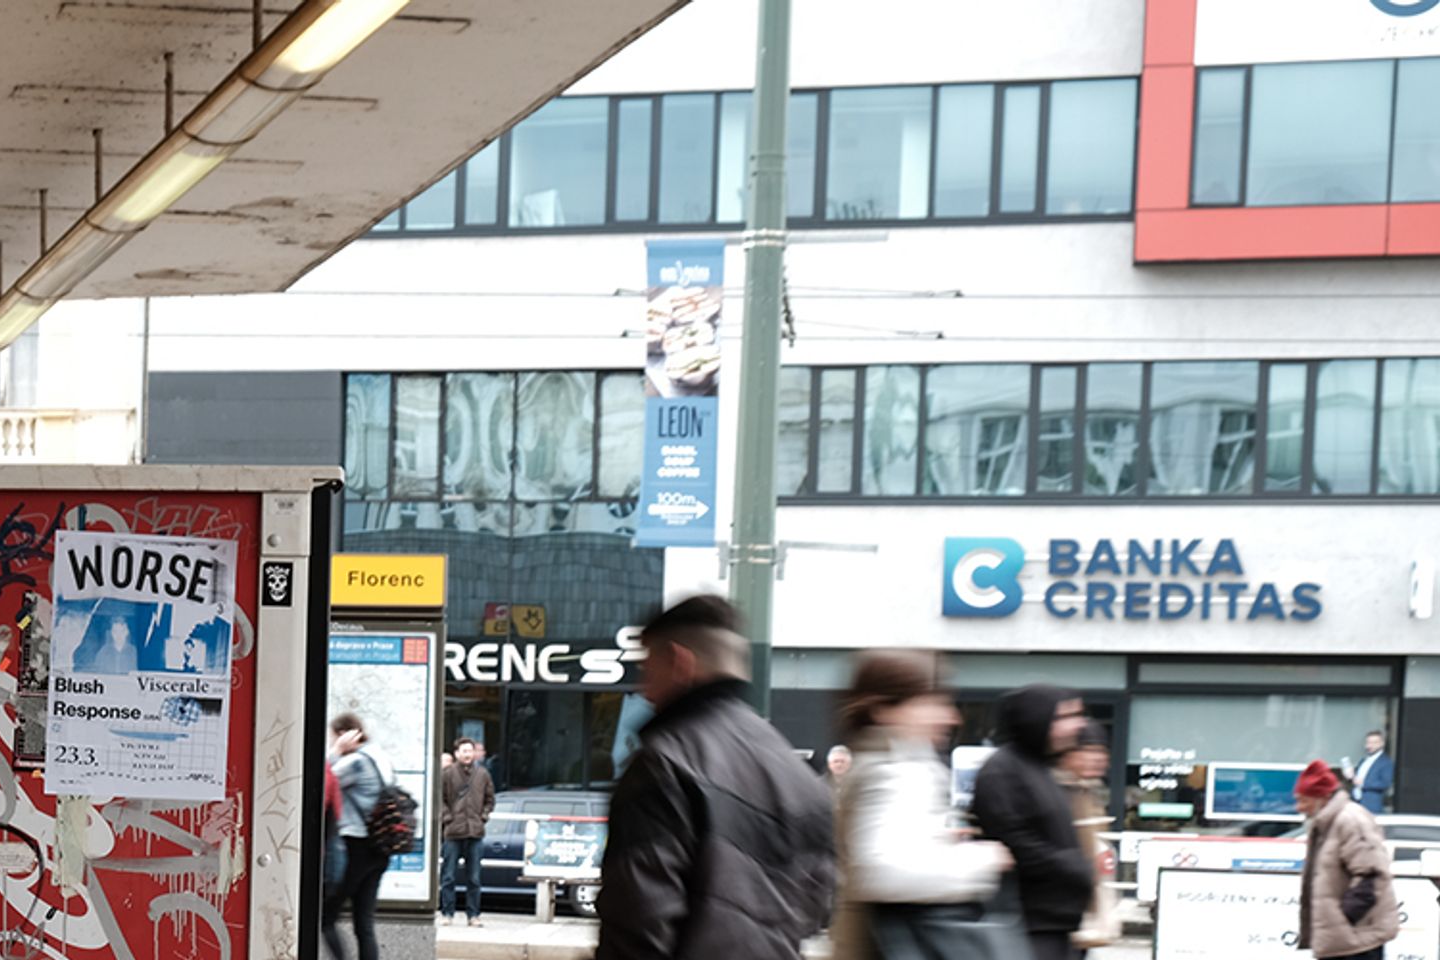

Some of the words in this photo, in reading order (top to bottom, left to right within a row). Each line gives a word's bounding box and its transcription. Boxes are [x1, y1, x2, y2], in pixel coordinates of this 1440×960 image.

[658, 405, 704, 438] LEON
[1047, 538, 1244, 577] BANKA
[67, 545, 213, 604] WORSE
[347, 570, 425, 587] Florenc
[1044, 580, 1323, 623] CREDITAS
[445, 642, 571, 682] RENC
[54, 676, 104, 695] Blush
[137, 677, 210, 694] Viscerale
[53, 700, 142, 721] Response
[54, 744, 99, 767] 23.3.
